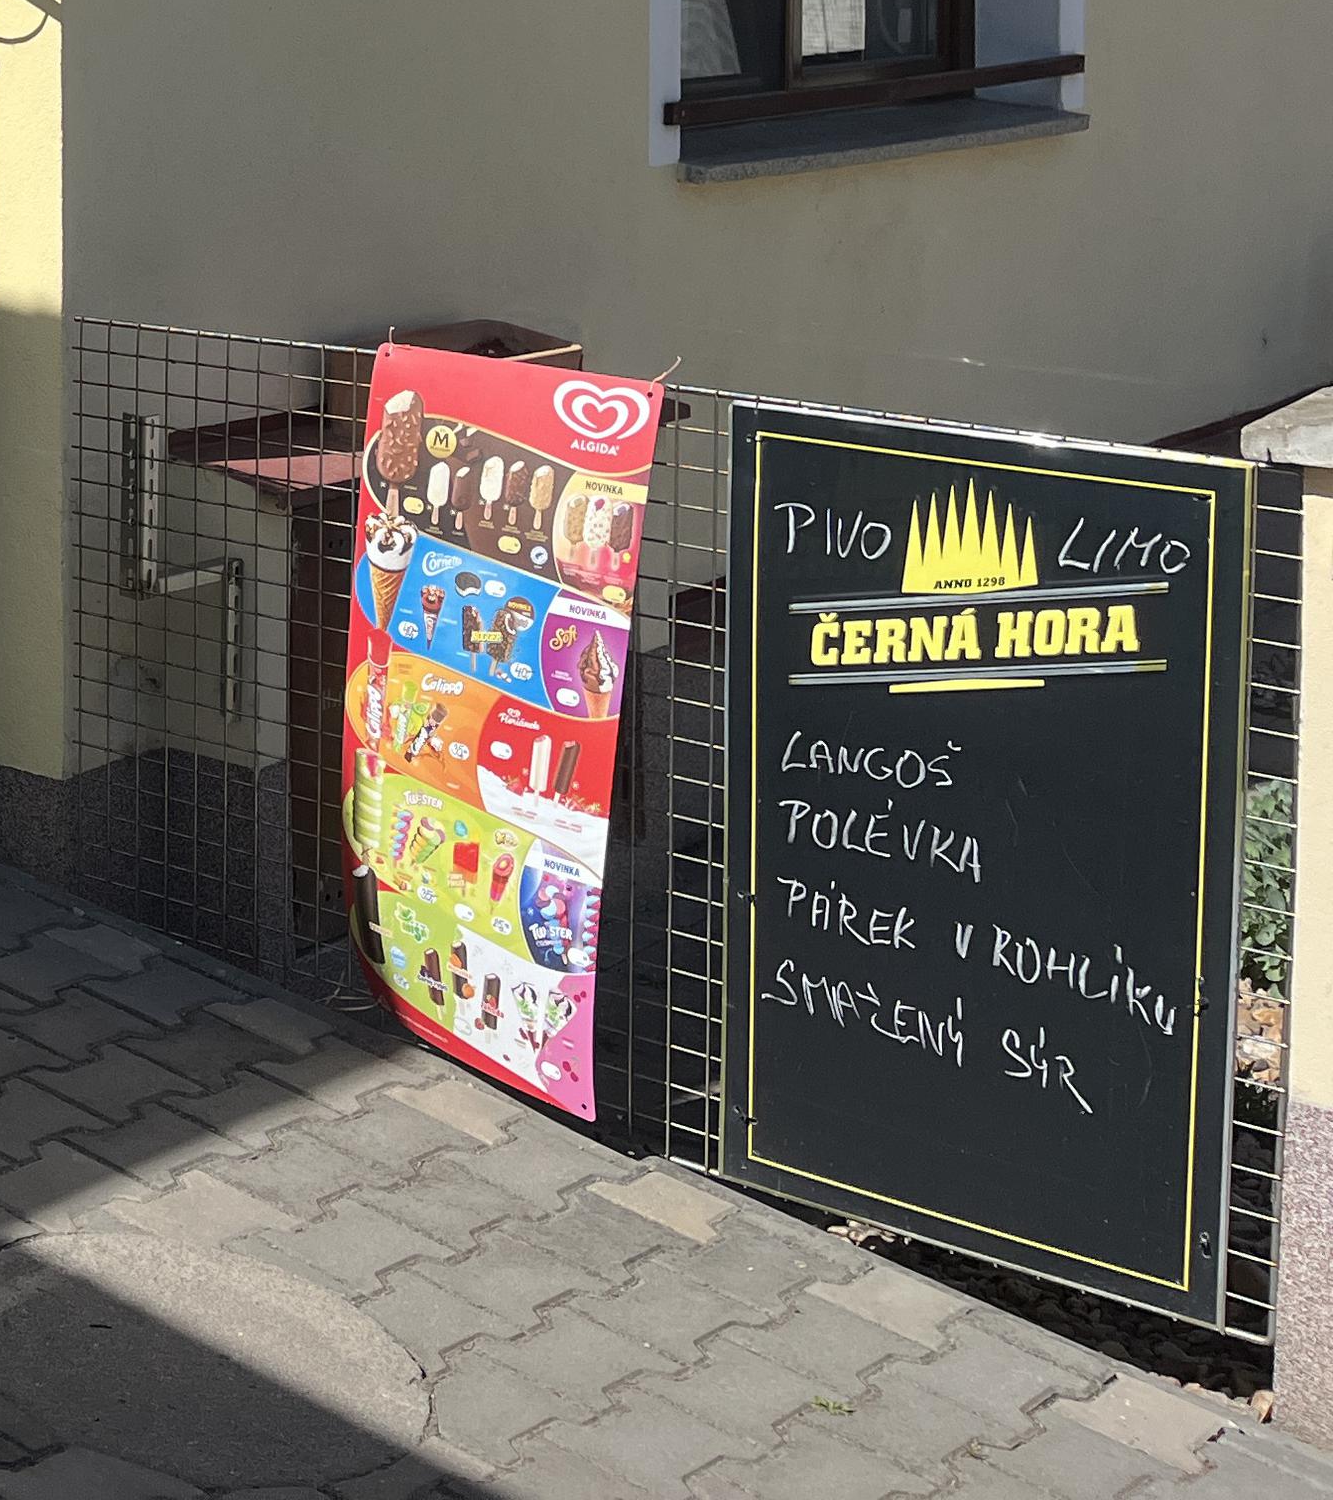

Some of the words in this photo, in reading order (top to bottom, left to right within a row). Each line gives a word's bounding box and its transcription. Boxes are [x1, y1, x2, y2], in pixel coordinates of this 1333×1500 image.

[570, 439, 620, 456] ALGIDA
[585, 480, 624, 496] NOVINKA
[773, 502, 893, 561] PIVO
[1056, 516, 1193, 575] LIMO
[933, 577, 973, 591] ANNO
[976, 576, 1006, 589] 1298
[569, 604, 607, 621] NOVINKA
[549, 624, 578, 651] Soft
[810, 606, 983, 669] ČERNÁ
[994, 604, 1141, 660] HORA
[421, 673, 463, 695] Calippo
[780, 729, 963, 789] LANGOŠ
[777, 798, 983, 884] POLÉVKA
[544, 858, 580, 877] NOVINKA
[776, 875, 917, 950] PÁREK
[990, 924, 1175, 1038] ROHLÍKU
[1002, 1027, 1093, 1114] SÝR
